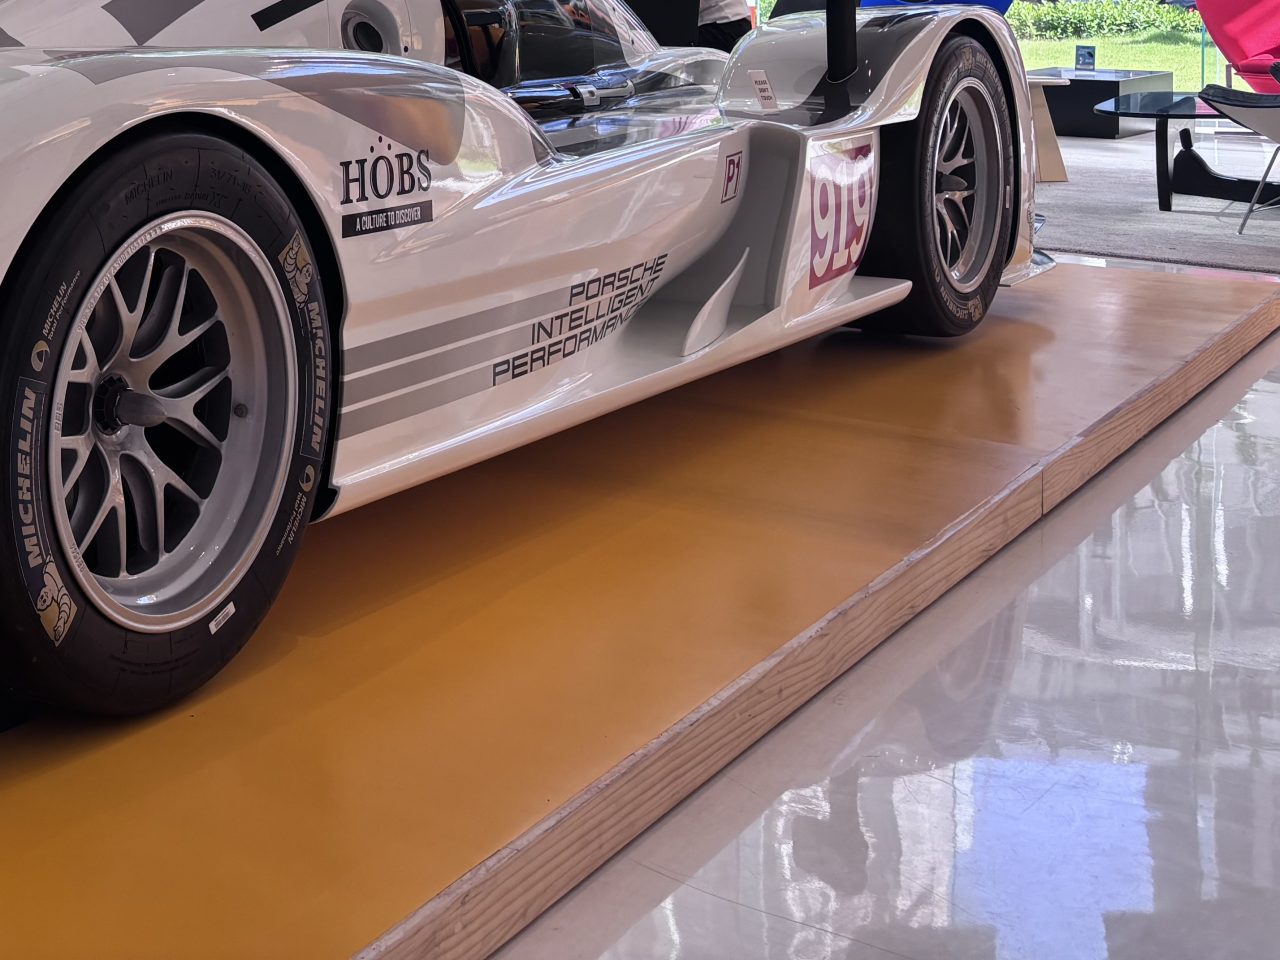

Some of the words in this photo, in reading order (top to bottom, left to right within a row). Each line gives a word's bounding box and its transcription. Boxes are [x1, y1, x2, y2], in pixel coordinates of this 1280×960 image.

[725, 157, 741, 197] P1
[356, 218, 361, 231] A
[361, 213, 387, 231] CULTURE
[387, 211, 395, 225] TO
[395, 206, 421, 224] DISCOVER
[812, 154, 871, 277] 919
[42, 281, 68, 337] MICHELIN
[48, 319, 57, 340] Total
[56, 270, 80, 319] Performance
[531, 275, 660, 346] INTELLIGENT
[569, 253, 668, 307] PORSCHE
[307, 301, 327, 453] MICHELIN
[17, 386, 43, 569] MICHELIN
[288, 494, 307, 544] MICHELIN
